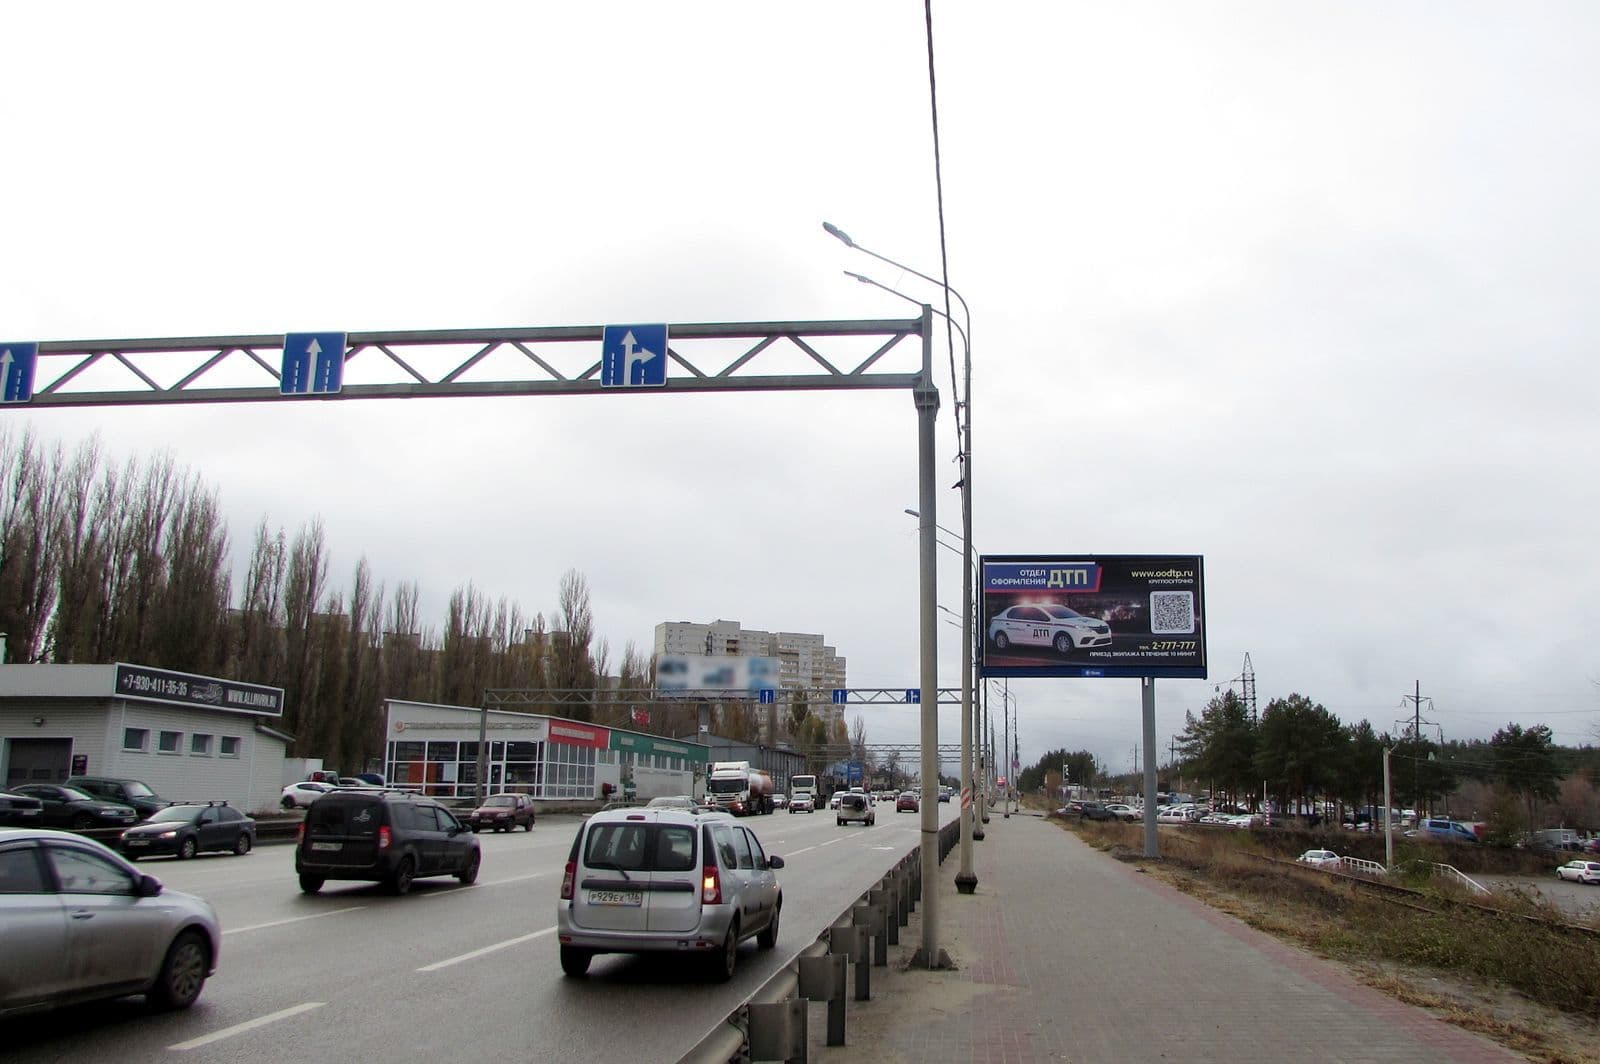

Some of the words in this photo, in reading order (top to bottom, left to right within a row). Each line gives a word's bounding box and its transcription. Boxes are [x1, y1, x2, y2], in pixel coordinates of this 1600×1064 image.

[1019, 569, 1046, 577] ОТДЕЛ
[1131, 569, 1193, 578] www.oodtp.ru
[1047, 569, 1088, 588] ДТП
[1033, 629, 1050, 639] ДТП
[1152, 641, 1196, 650] 2-777-777
